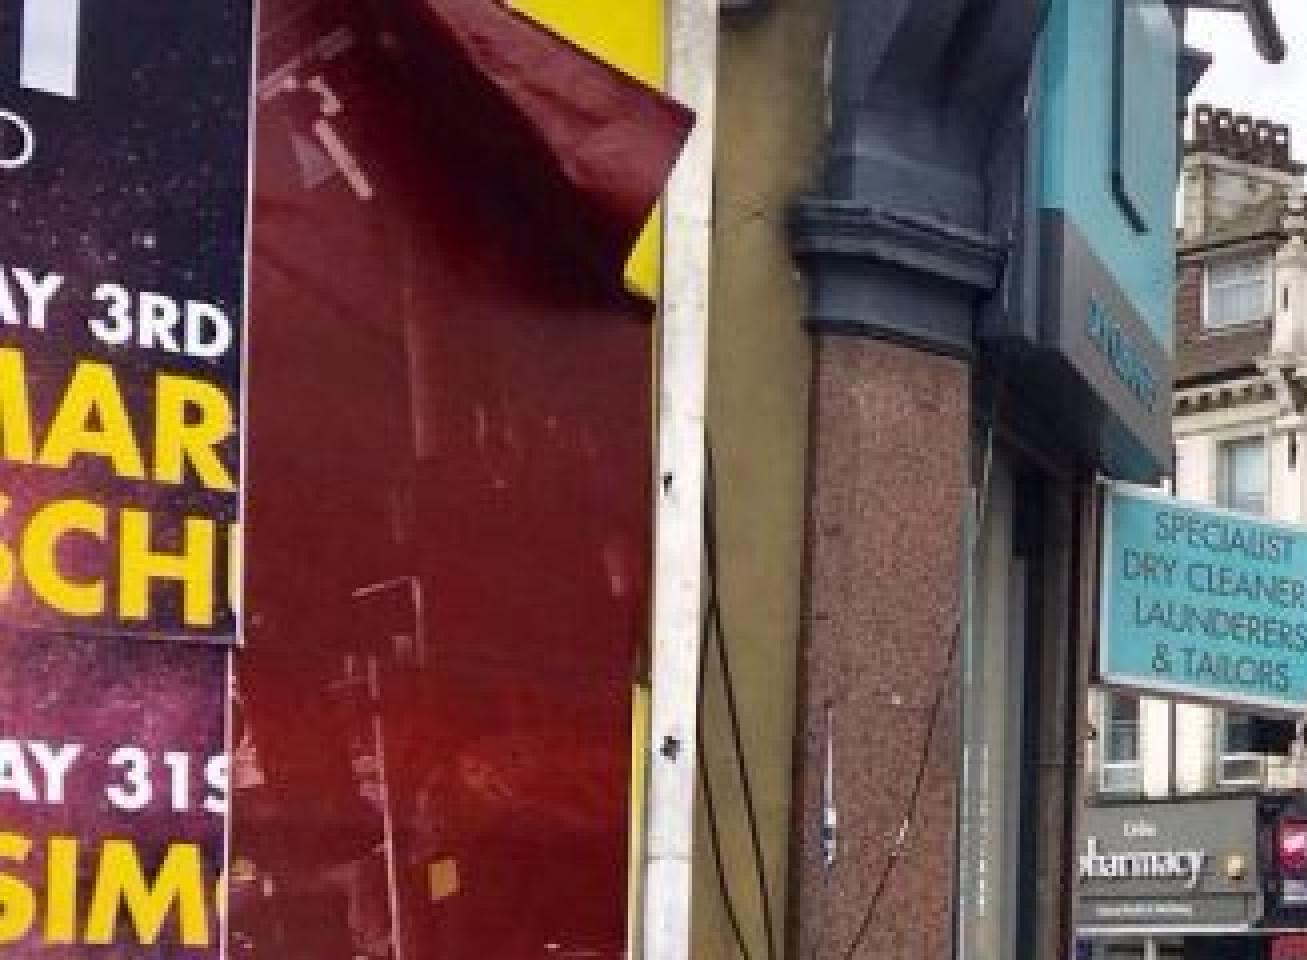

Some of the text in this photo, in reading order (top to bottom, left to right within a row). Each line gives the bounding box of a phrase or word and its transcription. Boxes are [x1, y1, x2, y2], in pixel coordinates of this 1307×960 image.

[88, 283, 233, 357] 3RD
[0, 347, 238, 491] AR
[0, 492, 240, 627] CH
[1123, 548, 1177, 586] DRY
[1154, 511, 1296, 565] SPECIALIST
[1151, 643, 1290, 692] & TAILORS
[0, 832, 227, 946] SIM
